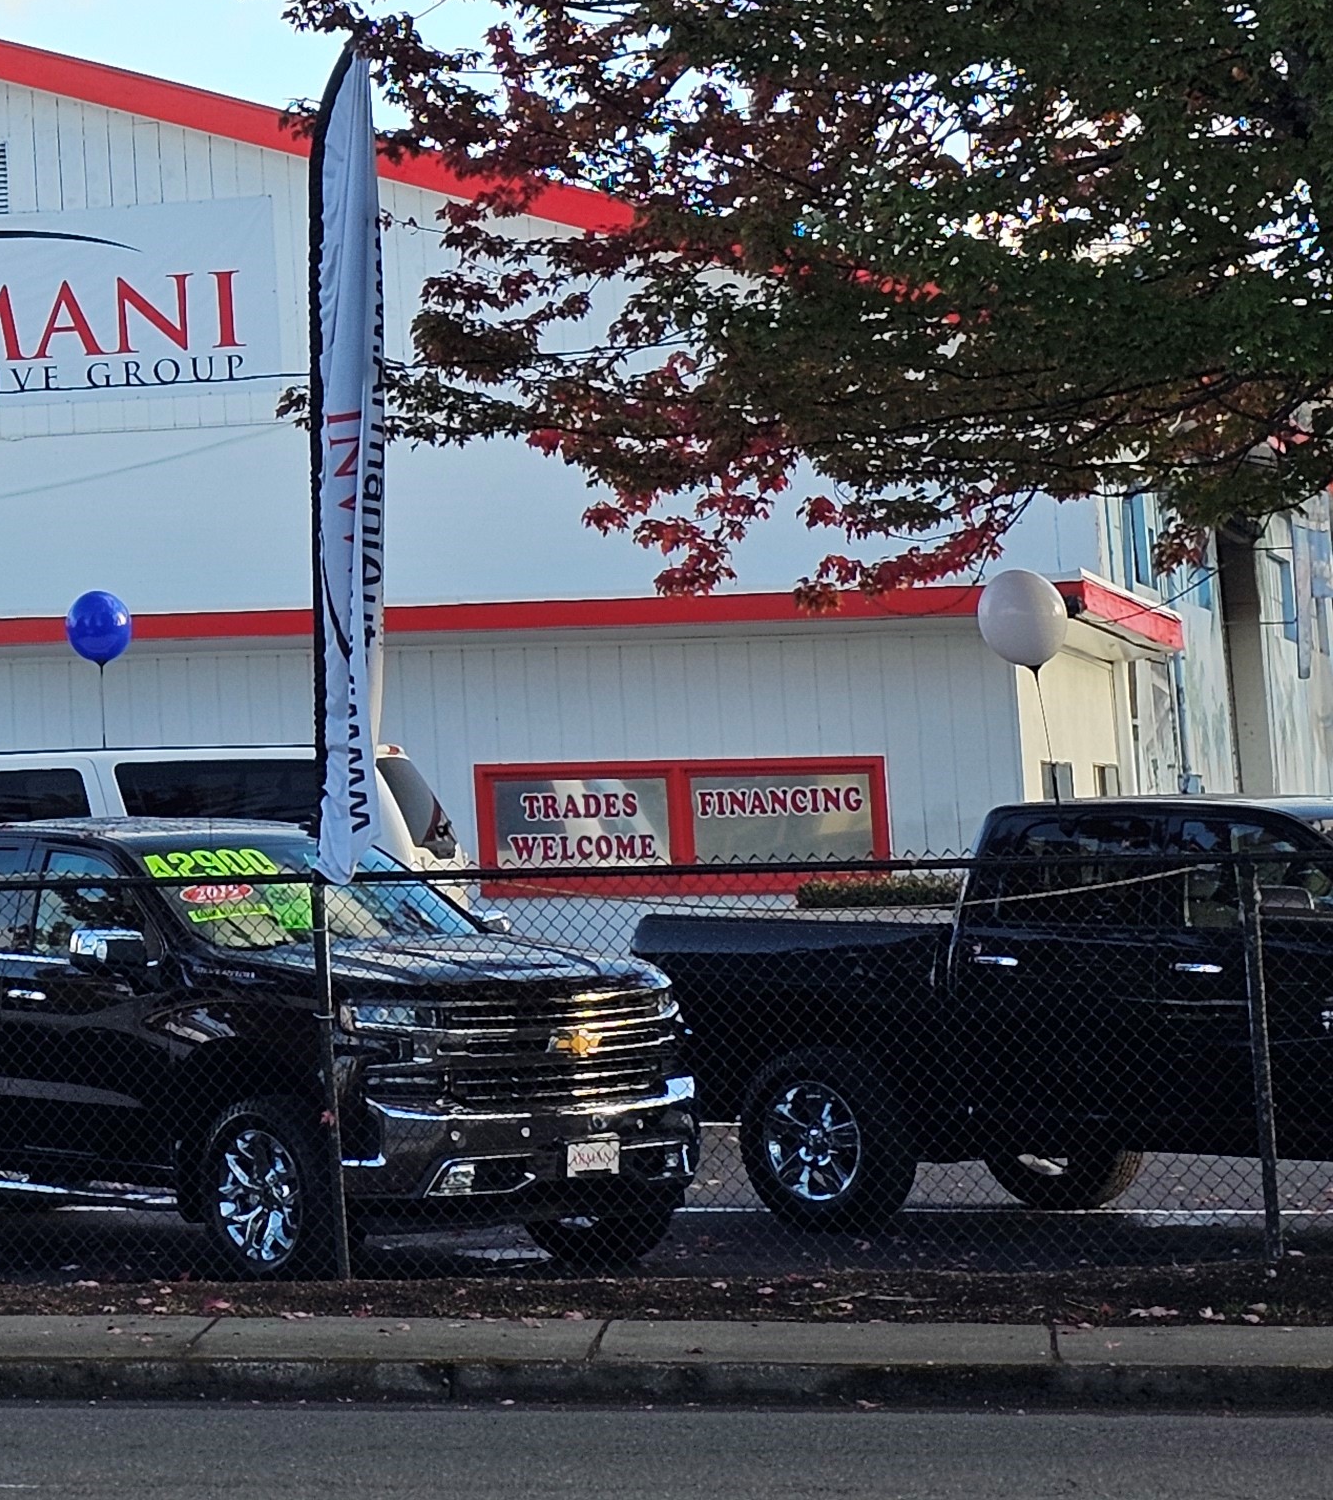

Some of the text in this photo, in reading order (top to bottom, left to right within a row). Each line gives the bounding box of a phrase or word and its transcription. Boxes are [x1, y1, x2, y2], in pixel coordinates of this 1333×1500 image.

[86, 354, 245, 388] GROUP
[521, 792, 639, 821] TRADES
[695, 786, 864, 819] FINANCING
[144, 848, 279, 878] 42900
[507, 834, 657, 862] WELCOME
